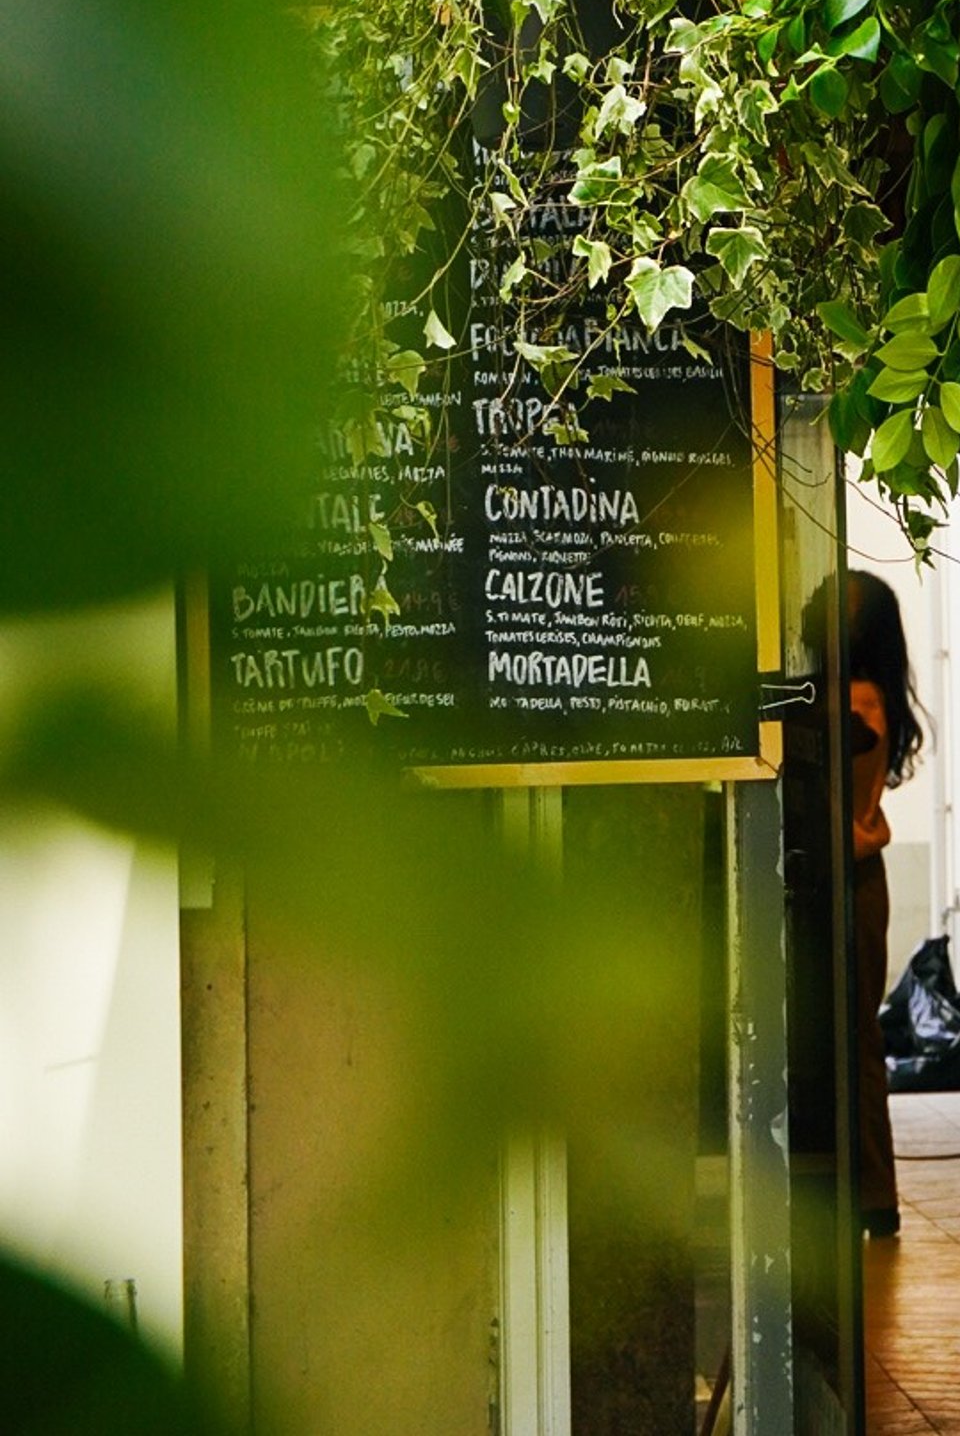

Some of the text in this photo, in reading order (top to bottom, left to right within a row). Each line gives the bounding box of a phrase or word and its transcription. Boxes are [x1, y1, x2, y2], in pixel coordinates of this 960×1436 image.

[484, 476, 640, 525] CONTADINA
[485, 568, 604, 608] CALZONE
[231, 646, 363, 689] TARTUFO
[488, 650, 652, 688] MORTADELLA
[489, 695, 569, 716] MOTADELLA,
